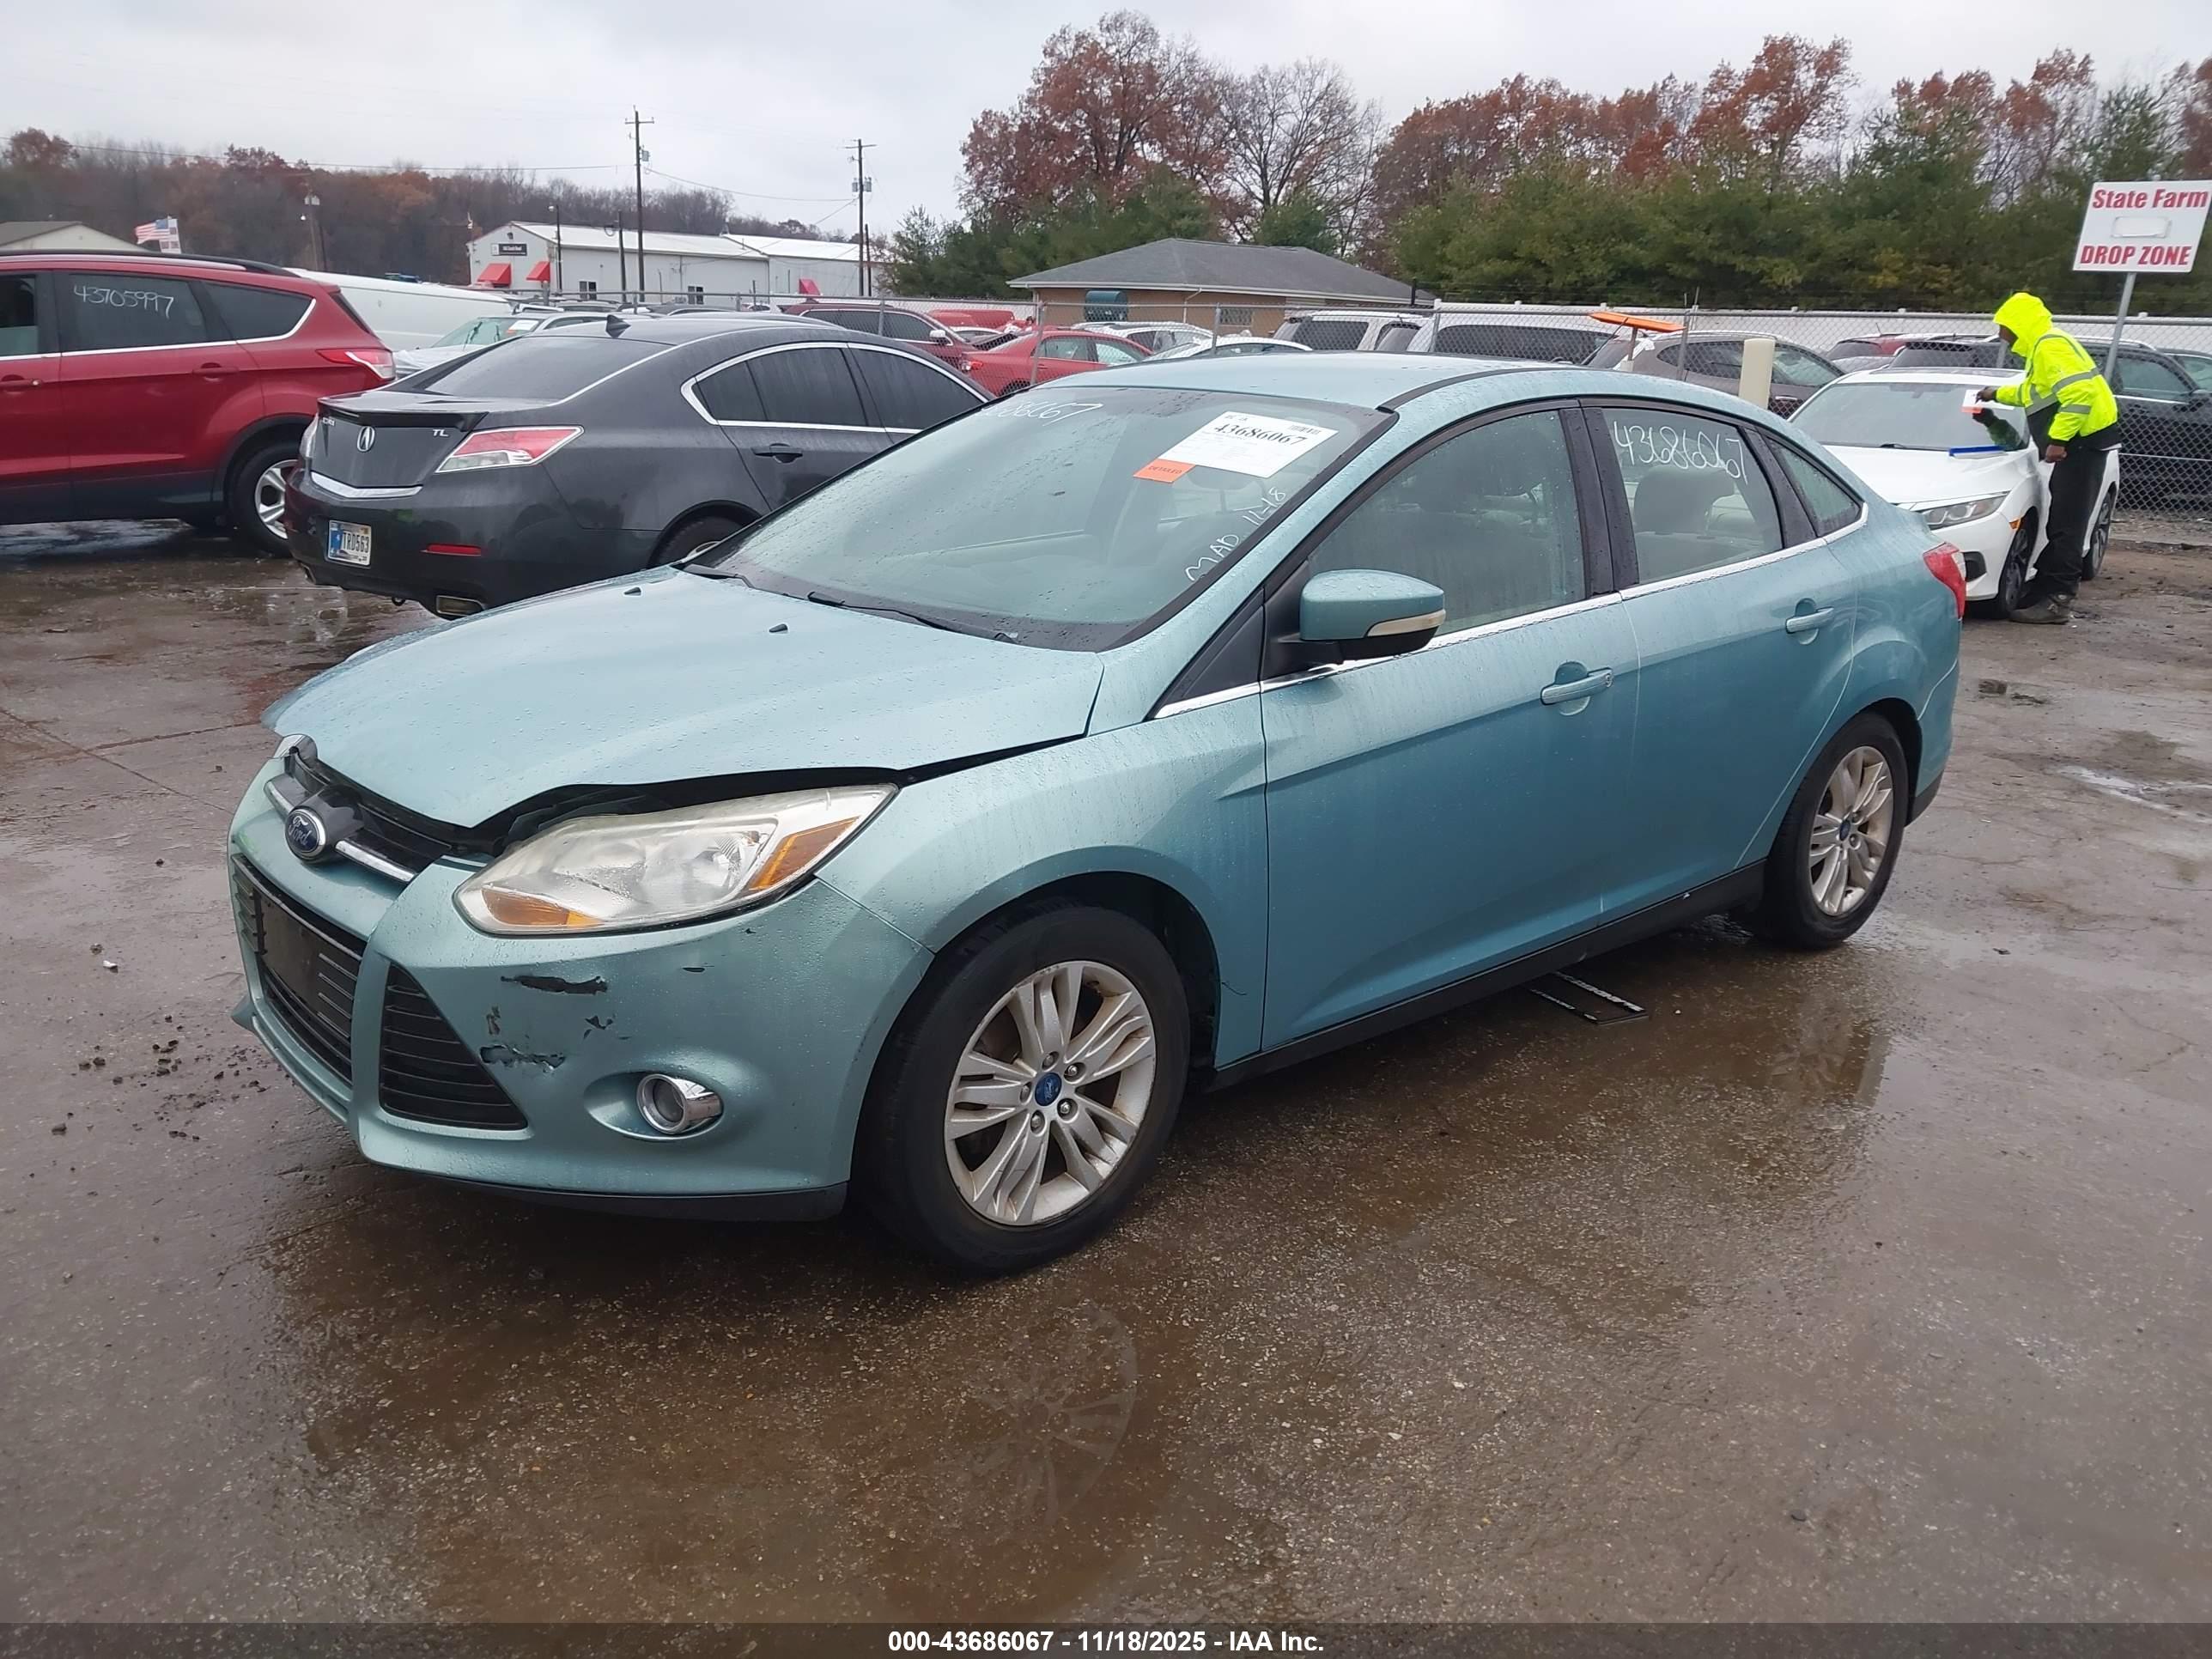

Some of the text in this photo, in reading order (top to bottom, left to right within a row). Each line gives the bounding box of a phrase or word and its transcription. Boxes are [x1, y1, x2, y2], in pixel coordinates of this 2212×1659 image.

[2093, 189, 2209, 208] State Farm
[2080, 246, 2192, 264] DROP ZONE
[74, 284, 173, 319] 43705997
[432, 428, 449, 437] TL
[1214, 422, 1309, 446] 43686067
[1613, 421, 1748, 485] 43686067
[1185, 534, 1240, 580] MAD
[289, 815, 312, 846] Ford
